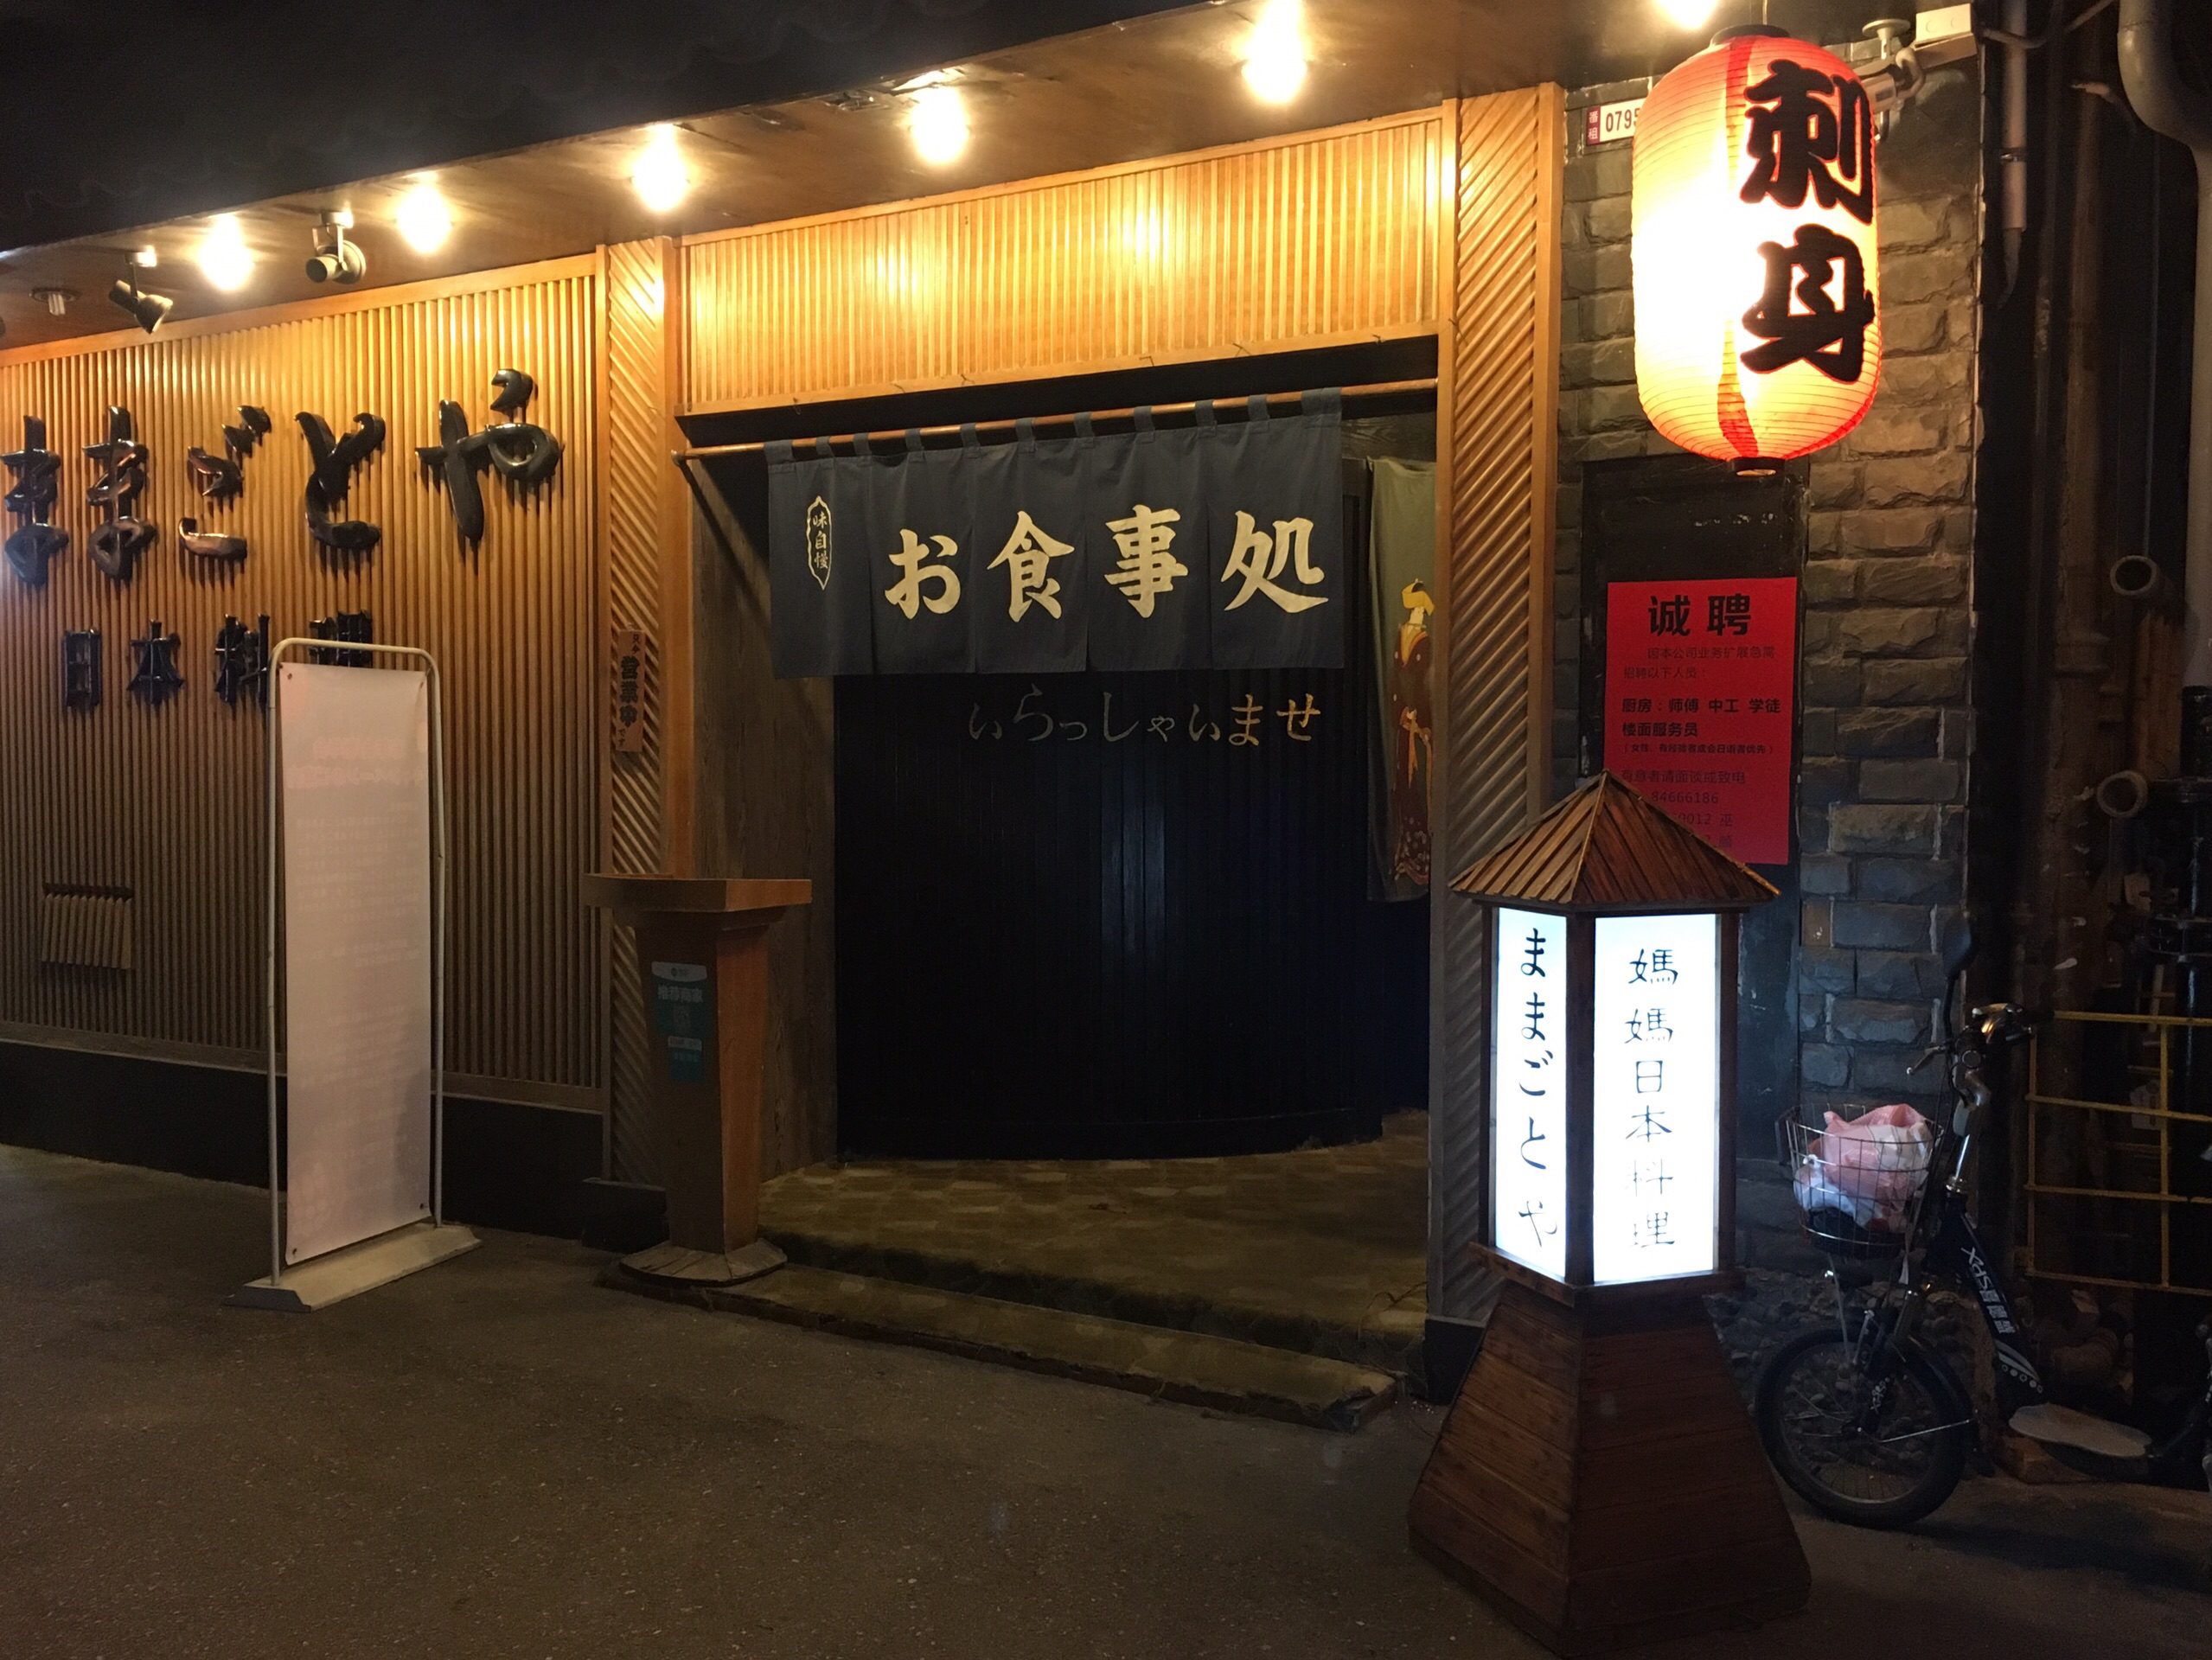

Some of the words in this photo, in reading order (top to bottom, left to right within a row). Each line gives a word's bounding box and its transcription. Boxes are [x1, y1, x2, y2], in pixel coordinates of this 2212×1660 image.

[1739, 58, 1876, 384] 刺身
[812, 510, 829, 570] 味自慢
[884, 503, 1330, 623] お食事処
[1647, 593, 1752, 636] 诚聘
[968, 682, 1321, 747] いらっしゃいませ
[1621, 722, 1699, 737] 楼面服务员
[1518, 927, 1558, 1248] ままごとや
[1624, 948, 1679, 1248] 媽媽日本料理
